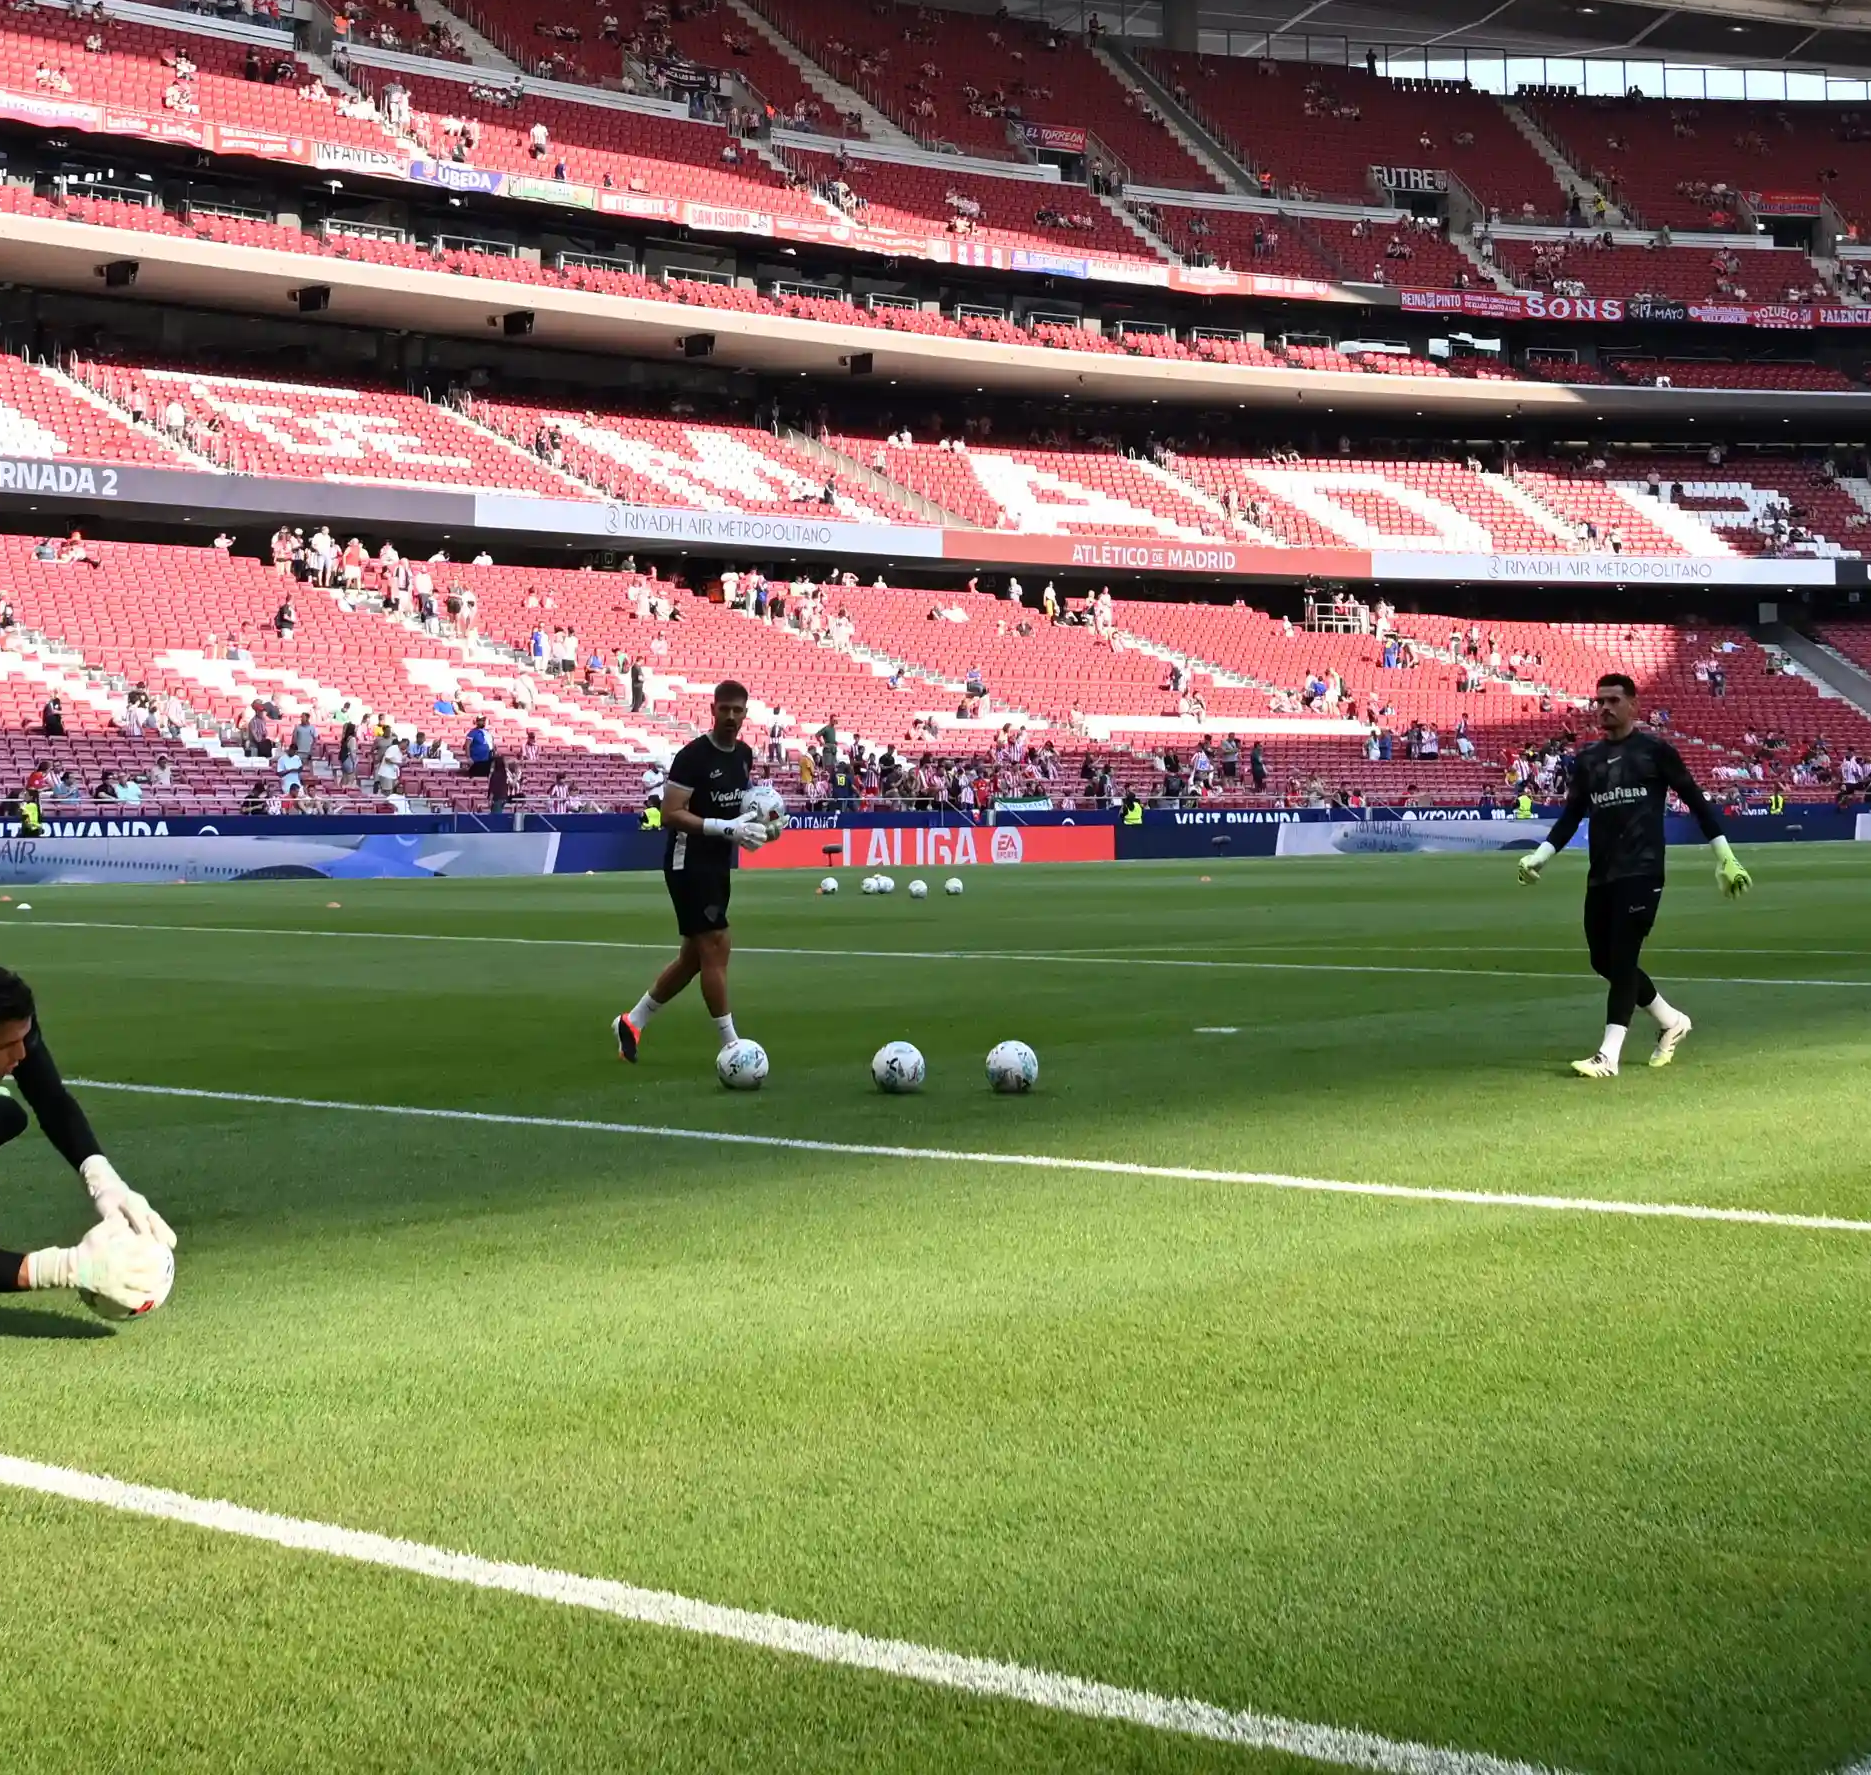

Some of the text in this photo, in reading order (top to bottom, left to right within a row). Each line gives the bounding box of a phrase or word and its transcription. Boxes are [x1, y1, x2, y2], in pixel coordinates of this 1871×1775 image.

[1370, 164, 1435, 190] FUTRE
[692, 208, 750, 228] SAN ISIDRO
[1401, 291, 1427, 308] REINA
[1436, 293, 1461, 308] PINTO
[1524, 296, 1624, 321] SONS
[1655, 308, 1684, 320] MAYO
[1753, 305, 1798, 322] POZUELO
[101, 468, 118, 496] 2
[623, 506, 831, 544] RIYADH AIR METROPOLITANO
[1072, 542, 1149, 568] ATLÉTICO
[1167, 549, 1236, 571] MADRID
[1505, 559, 1713, 578] RIYADH AIR METROPOLITANO
[996, 834, 1018, 850] EA
